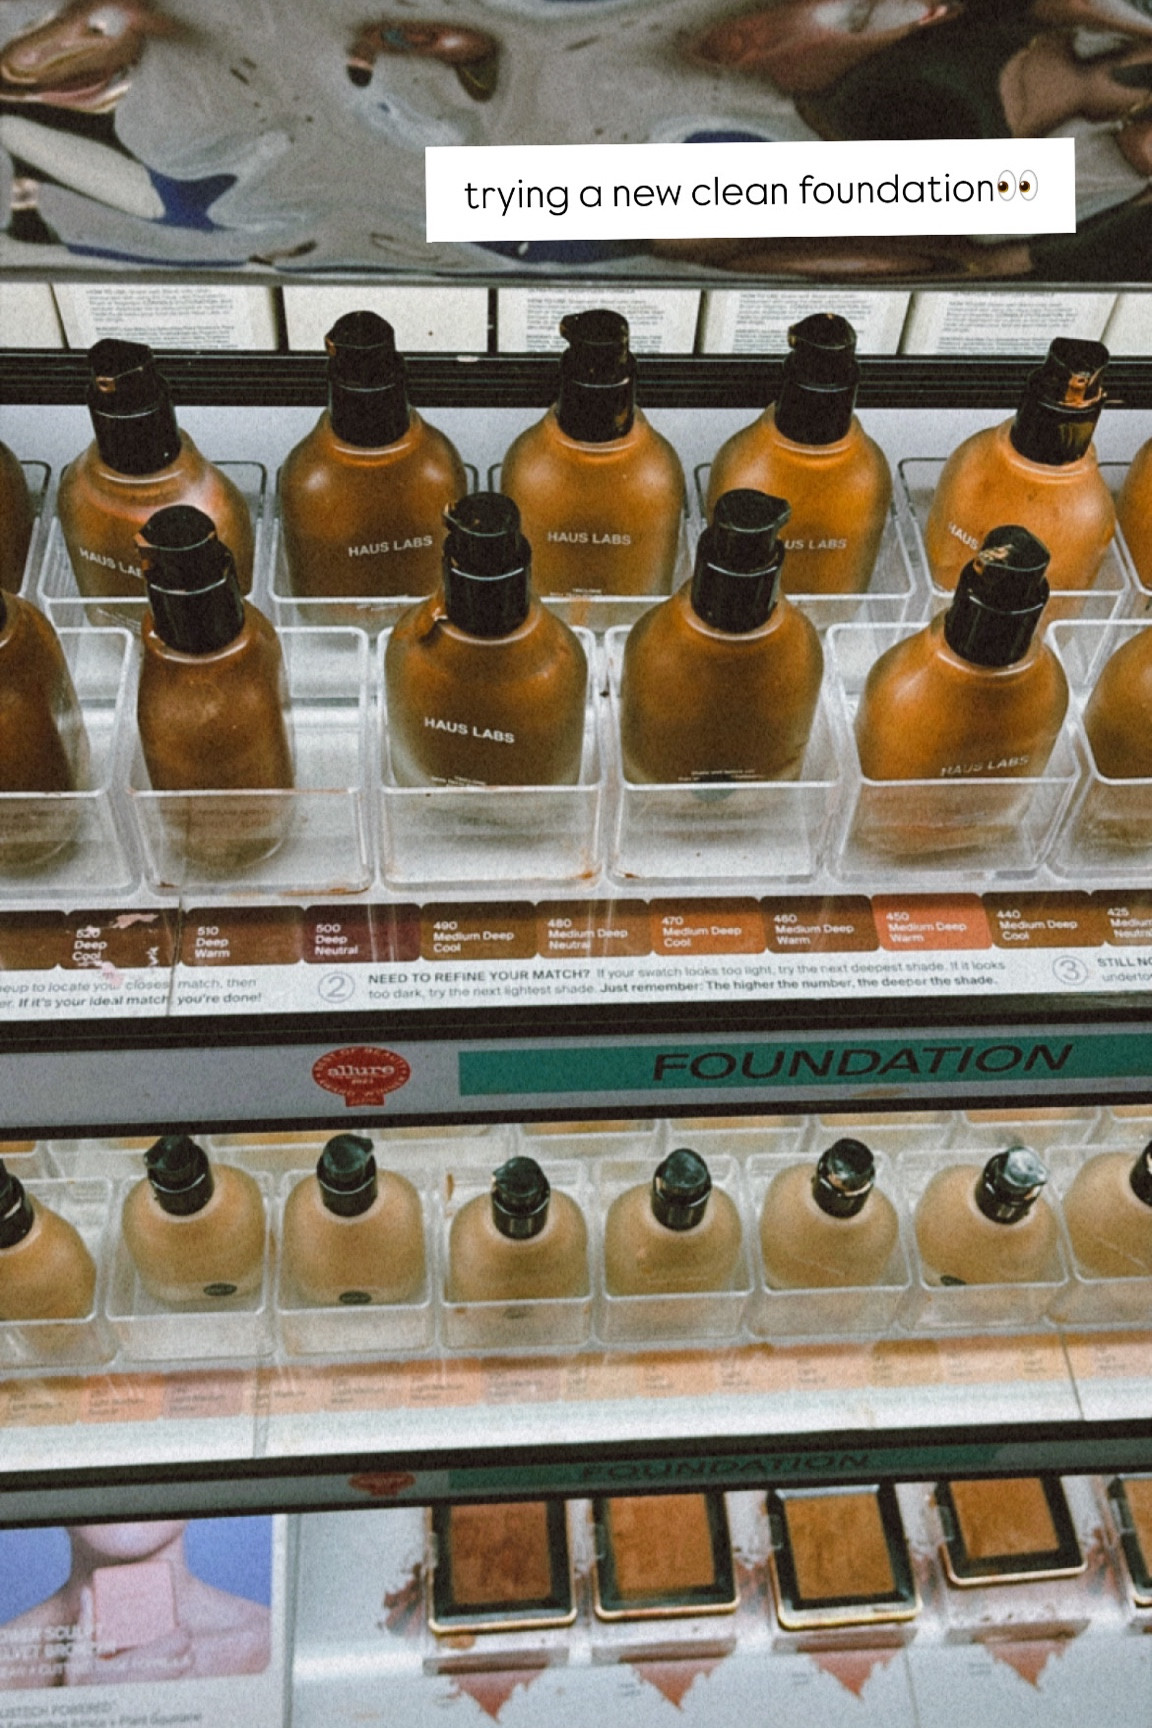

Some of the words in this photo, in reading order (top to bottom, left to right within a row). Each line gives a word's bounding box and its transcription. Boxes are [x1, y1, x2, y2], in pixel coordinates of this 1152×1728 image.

[547, 531, 589, 545] HAUS
[591, 532, 632, 547] LABS
[948, 520, 978, 551] HAUS
[347, 541, 390, 558] HAUS
[392, 534, 433, 552] LABS
[783, 538, 804, 550] US
[808, 537, 848, 550] LABS
[79, 546, 116, 569] HAUS
[424, 716, 469, 736] HAUS
[472, 725, 516, 745] LABS
[941, 761, 984, 777] HAUS
[986, 753, 1031, 771] LABS
[773, 913, 798, 924] 460
[886, 911, 910, 922] 450
[997, 909, 1022, 919] 440
[433, 920, 459, 931] 490
[547, 918, 573, 929] 480
[662, 915, 684, 926] 470
[999, 919, 1046, 930] Medium
[1047, 919, 1079, 931] Deep
[197, 926, 219, 937] 510
[316, 923, 342, 934] 500
[663, 926, 710, 937] Medium
[711, 925, 742, 938] Deep
[775, 923, 822, 934] Medium
[823, 923, 855, 935] Deep
[887, 921, 935, 932] Medium
[935, 921, 968, 933] Deep
[315, 933, 349, 945] Deep
[433, 931, 481, 942] Medium
[482, 930, 515, 943] Deep
[548, 928, 595, 939] Medium
[597, 927, 628, 940] Deep
[889, 932, 924, 943] Warm
[1002, 930, 1030, 942] Cool
[74, 940, 108, 950] Deep
[196, 937, 230, 949] Deep
[549, 939, 592, 950] Neutral
[664, 937, 692, 948] Cool
[776, 935, 811, 945] Warm
[195, 948, 231, 959] Warm
[315, 945, 359, 956] Neutral
[433, 942, 461, 954] Cool
[72, 951, 102, 961] Cool
[1097, 957, 1136, 968] STILL
[368, 973, 408, 984] NEED
[412, 972, 432, 983] TO
[434, 971, 485, 982] REFINE
[489, 970, 529, 981] YOUR
[532, 968, 590, 980] MATCH?
[608, 969, 635, 980] your
[638, 966, 682, 977] swatch
[684, 966, 719, 976] looks
[721, 966, 742, 976] too
[778, 965, 796, 977] try
[797, 964, 817, 975] the
[820, 964, 848, 974] next
[850, 962, 902, 975] deepest
[972, 960, 1006, 971] looks
[1102, 971, 1152, 982] underto
[33, 982, 46, 992] to
[48, 981, 90, 992] locate
[178, 978, 223, 989] match,
[226, 977, 257, 988] then
[368, 989, 389, 1000] too
[393, 988, 426, 1001] dark,
[428, 988, 446, 1001] try
[449, 986, 471, 998] the
[473, 986, 501, 997] next
[504, 984, 552, 998] lightest
[600, 983, 628, 993] Just
[632, 981, 703, 993] remember:
[706, 980, 730, 991] The
[733, 979, 774, 992] higher
[777, 979, 799, 990] the
[801, 978, 856, 991] number,
[858, 977, 879, 988] the
[881, 977, 927, 990] deeper
[930, 976, 951, 987] the
[954, 975, 999, 986] shade.
[18, 997, 29, 1009] If
[31, 996, 52, 1008] it's
[55, 998, 87, 1010] your
[89, 995, 123, 1006] ideal
[178, 992, 220, 1006] you're
[222, 991, 262, 1004] done!
[651, 1043, 1074, 1081] FOUNDATION
[328, 1065, 394, 1076] allure
[582, 1451, 870, 1480] FOUNDATION
